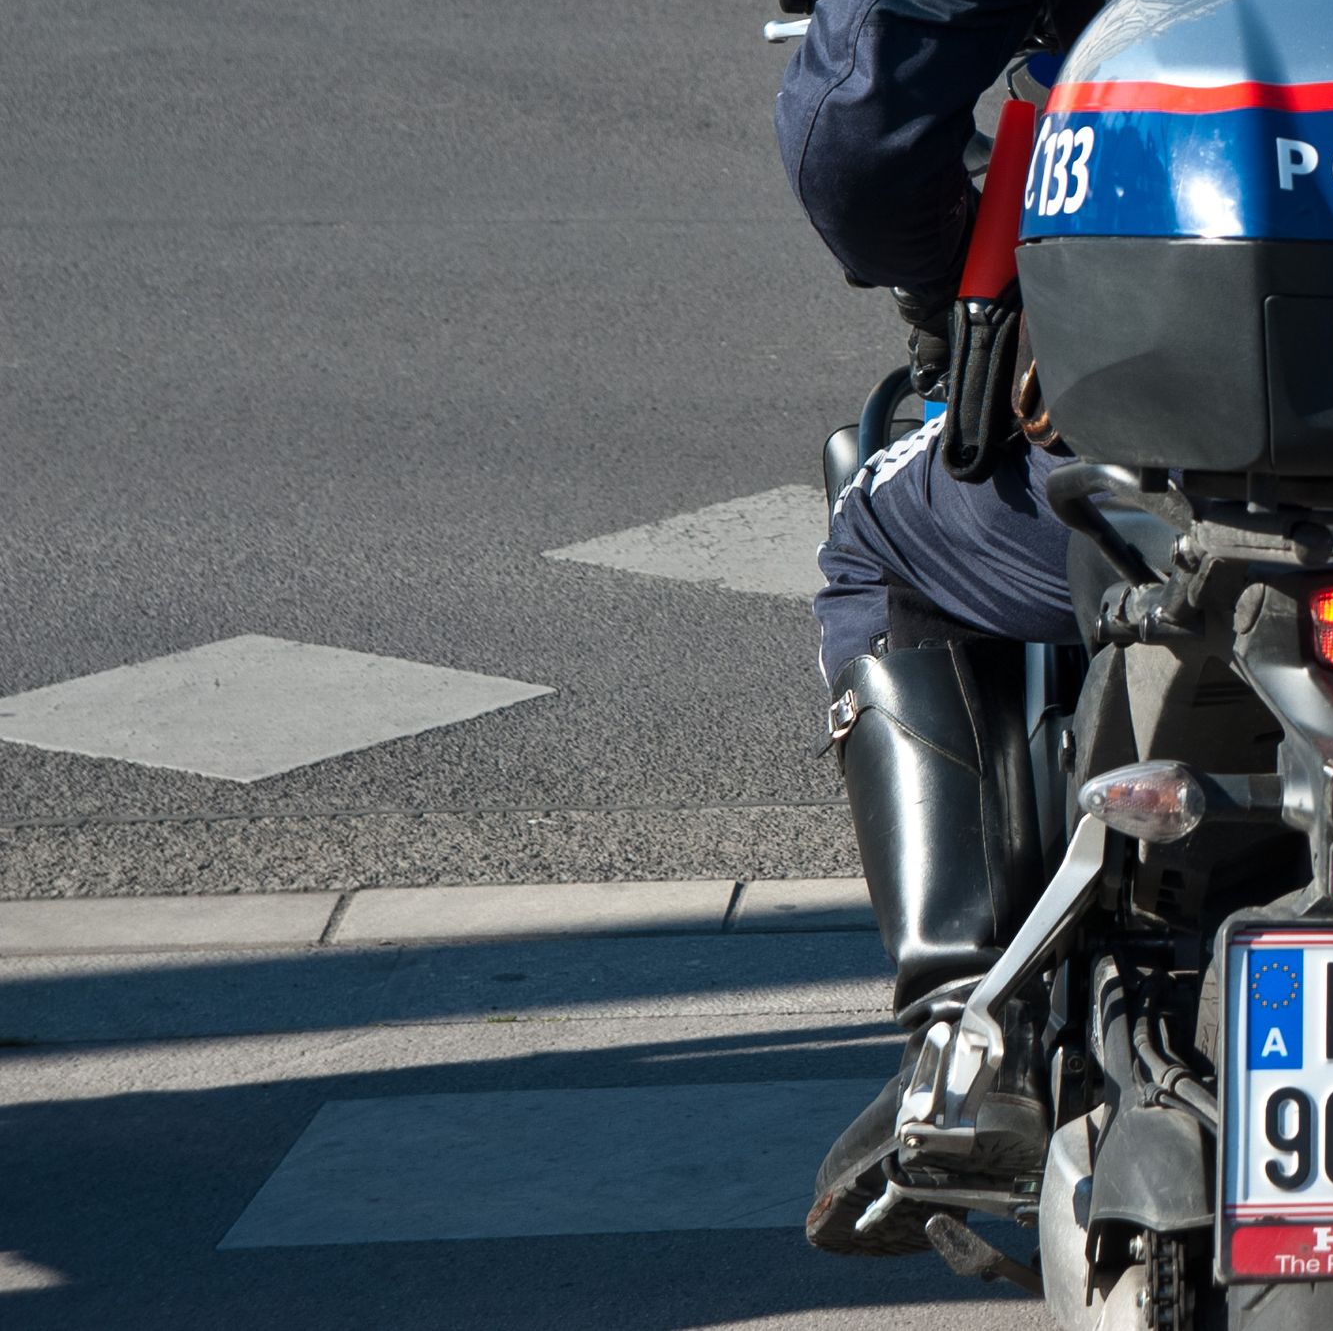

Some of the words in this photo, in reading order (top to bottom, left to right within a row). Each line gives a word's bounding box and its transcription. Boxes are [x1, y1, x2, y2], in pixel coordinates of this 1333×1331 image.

[1038, 125, 1095, 216] 133
[1261, 1027, 1288, 1057] A
[1275, 1254, 1320, 1274] The
